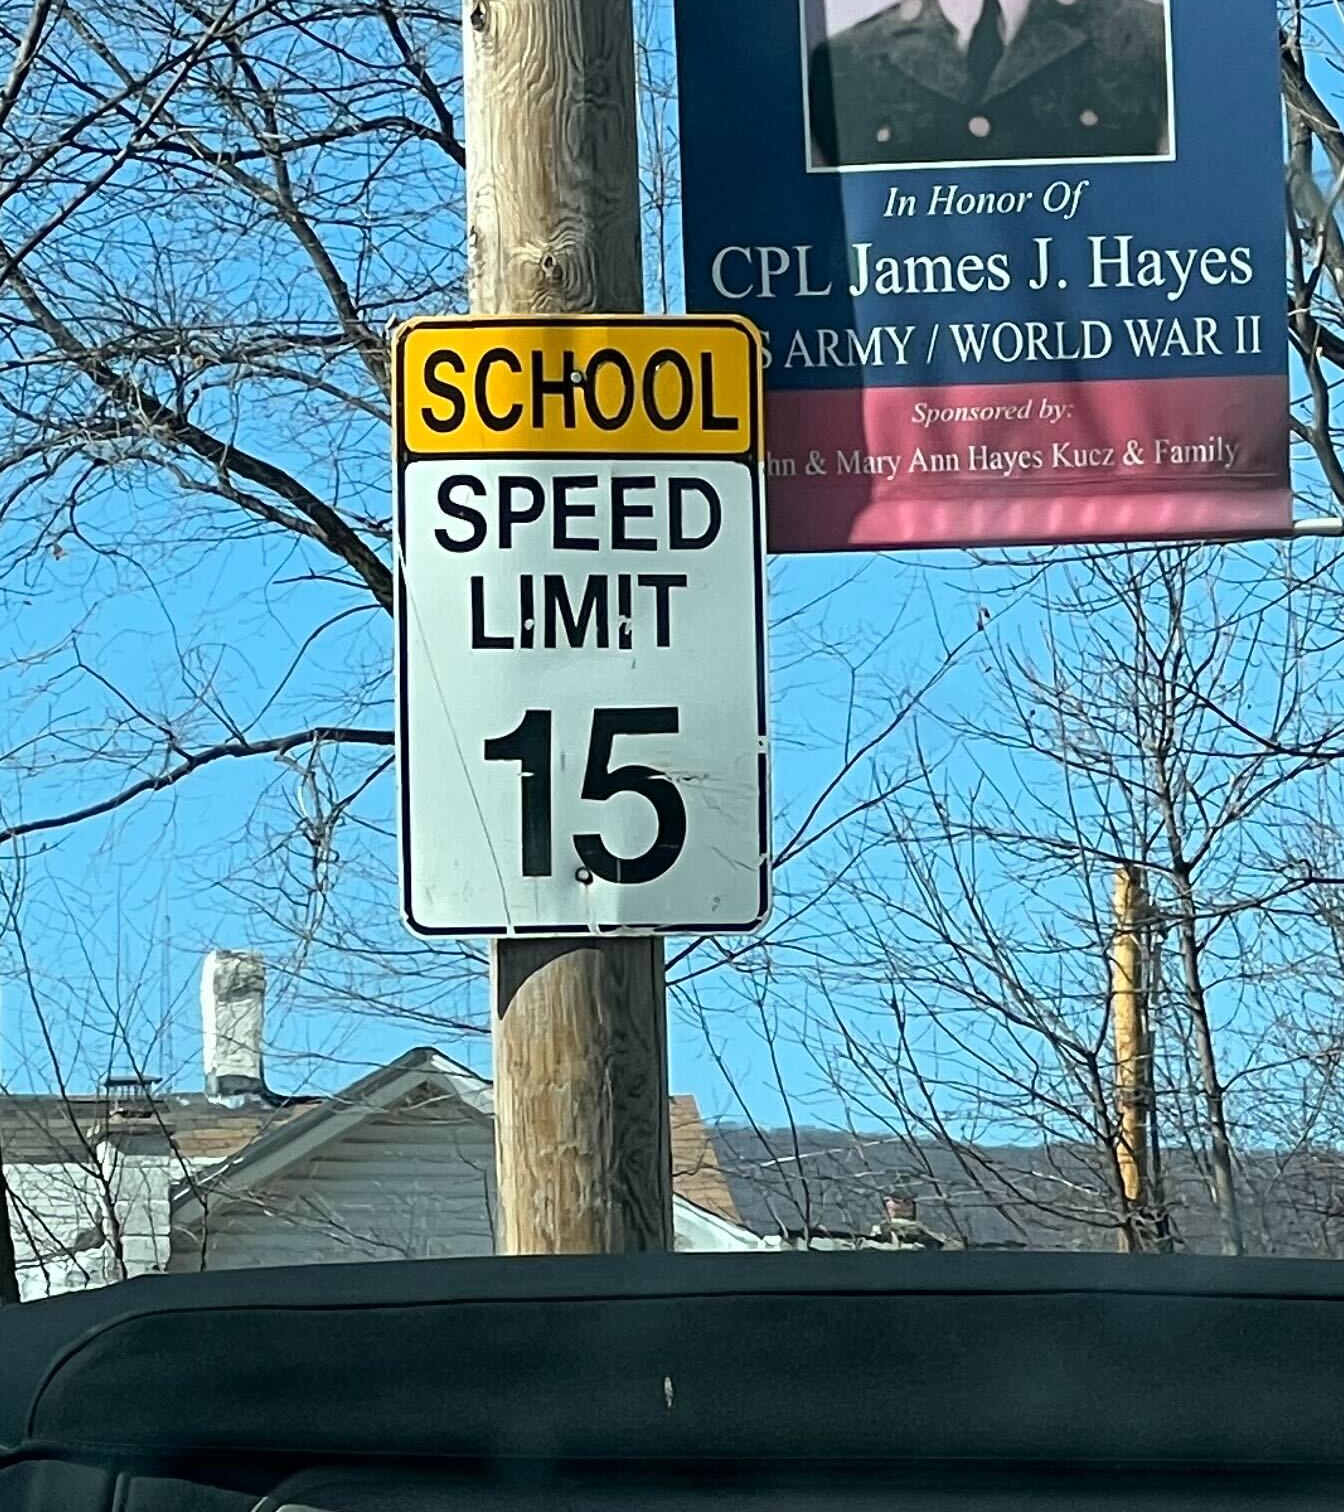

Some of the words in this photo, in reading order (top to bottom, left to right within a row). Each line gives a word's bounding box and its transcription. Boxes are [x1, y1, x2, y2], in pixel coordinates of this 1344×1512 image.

[883, 186, 914, 218] In
[926, 182, 1032, 217] Honor
[1042, 178, 1090, 220] Of
[712, 246, 832, 298] CPL
[849, 243, 1011, 296] James
[1029, 236, 1068, 290] J.
[1088, 235, 1253, 301] Hayes
[759, 330, 773, 369] S
[784, 326, 916, 368] ARMY
[925, 323, 939, 364] /
[951, 318, 1113, 364] WORLD
[1124, 317, 1223, 358] WAR
[1234, 314, 1262, 355] II
[421, 347, 739, 432] SCHOOL
[911, 399, 1032, 427] Sponsored
[767, 451, 797, 476] hn
[804, 449, 828, 476] &
[836, 449, 902, 482] Mary
[908, 446, 961, 474] Ann
[968, 442, 1043, 478] Hayes
[1121, 439, 1146, 467] &
[1154, 435, 1240, 470] Family
[433, 473, 724, 554] SPEED
[470, 573, 689, 651] LIMIT
[483, 705, 688, 886] 15
